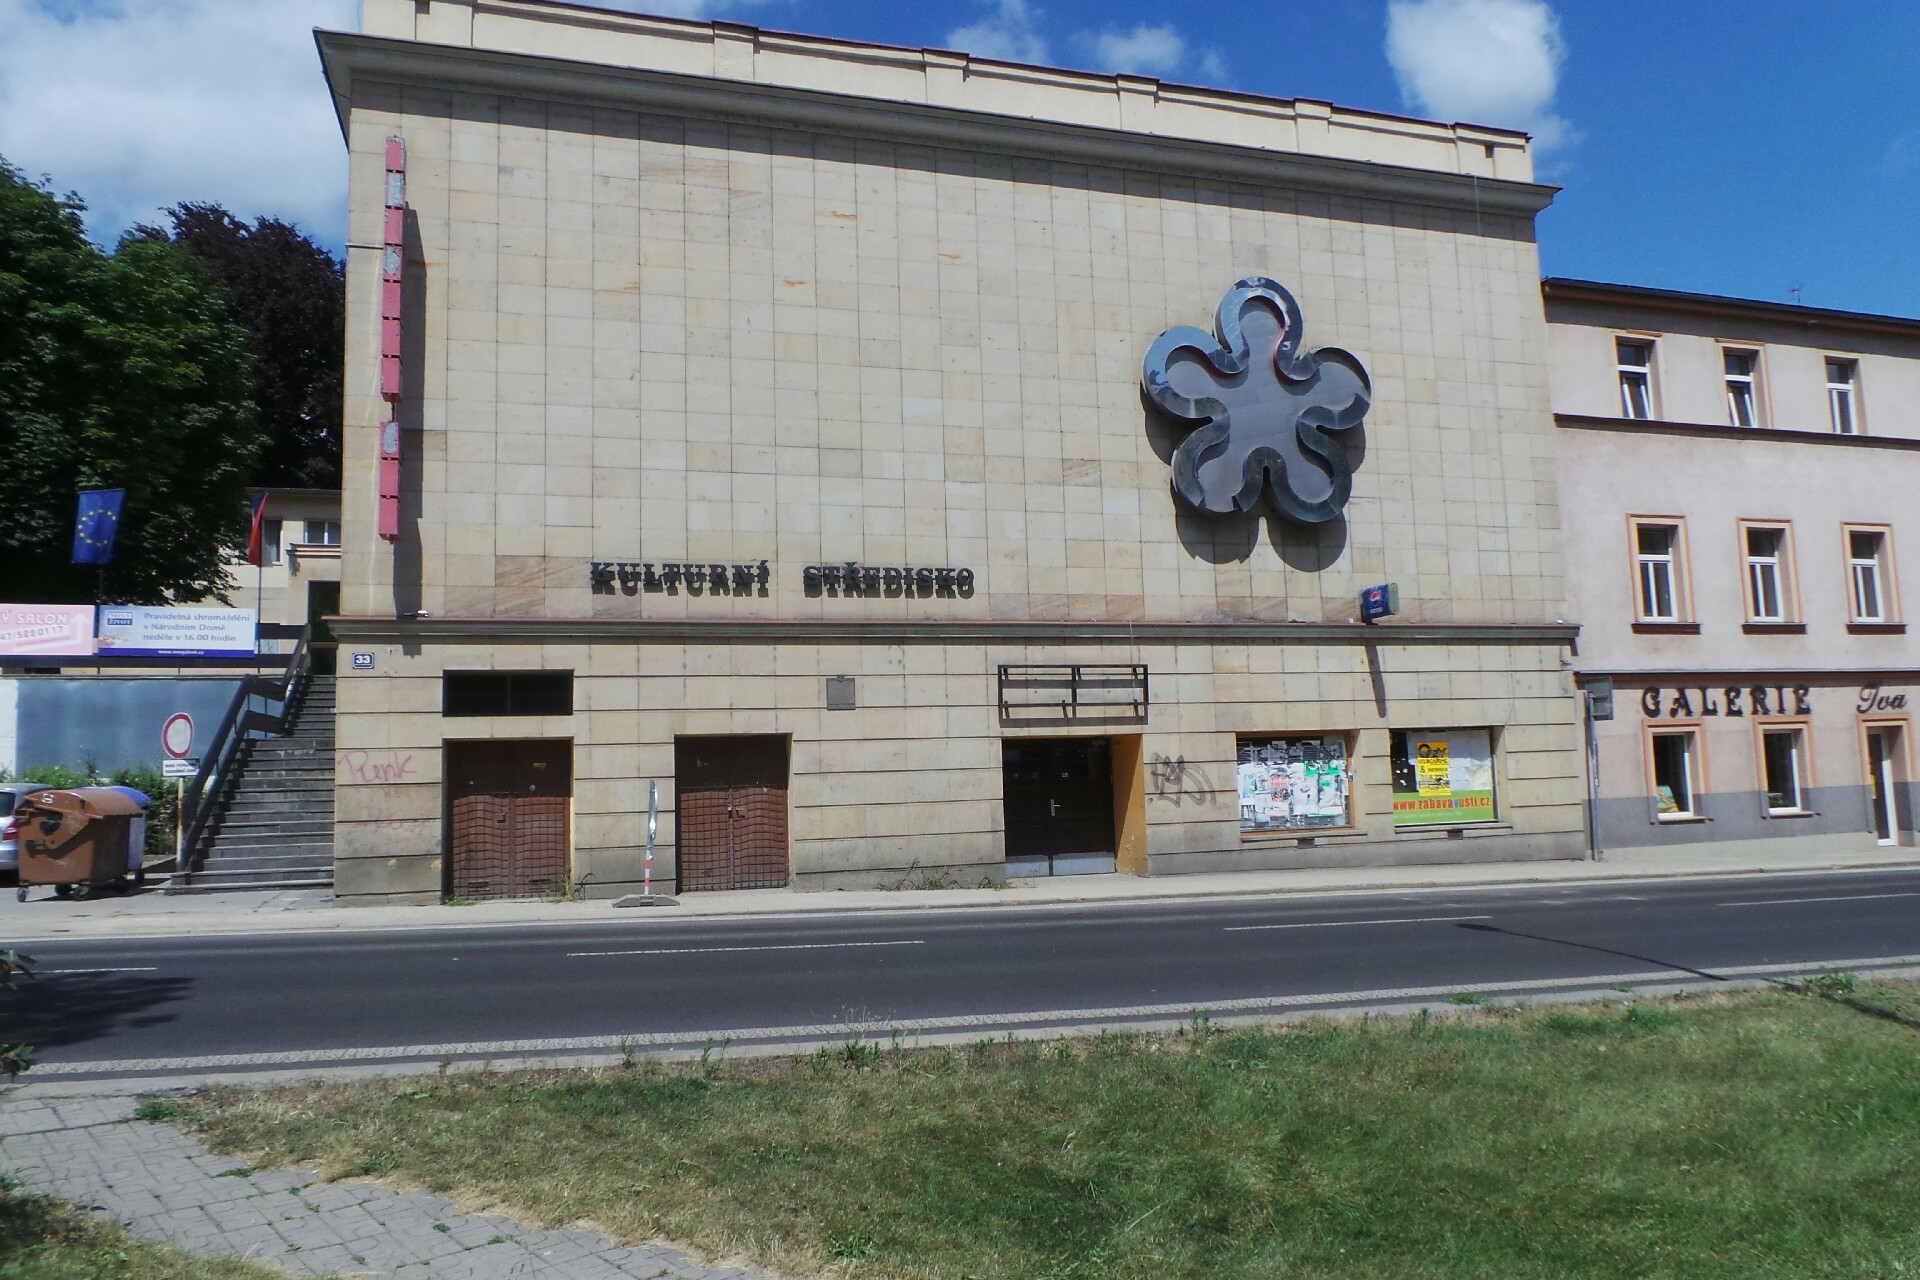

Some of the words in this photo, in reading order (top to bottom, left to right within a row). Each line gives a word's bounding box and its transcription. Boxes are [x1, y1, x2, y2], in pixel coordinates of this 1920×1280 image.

[591, 559, 769, 590] KULTURNÍ
[803, 561, 974, 590] STŘEDISKO
[16, 613, 69, 625] SALON
[355, 655, 371, 664] 33
[1642, 684, 1812, 718] GALERIE
